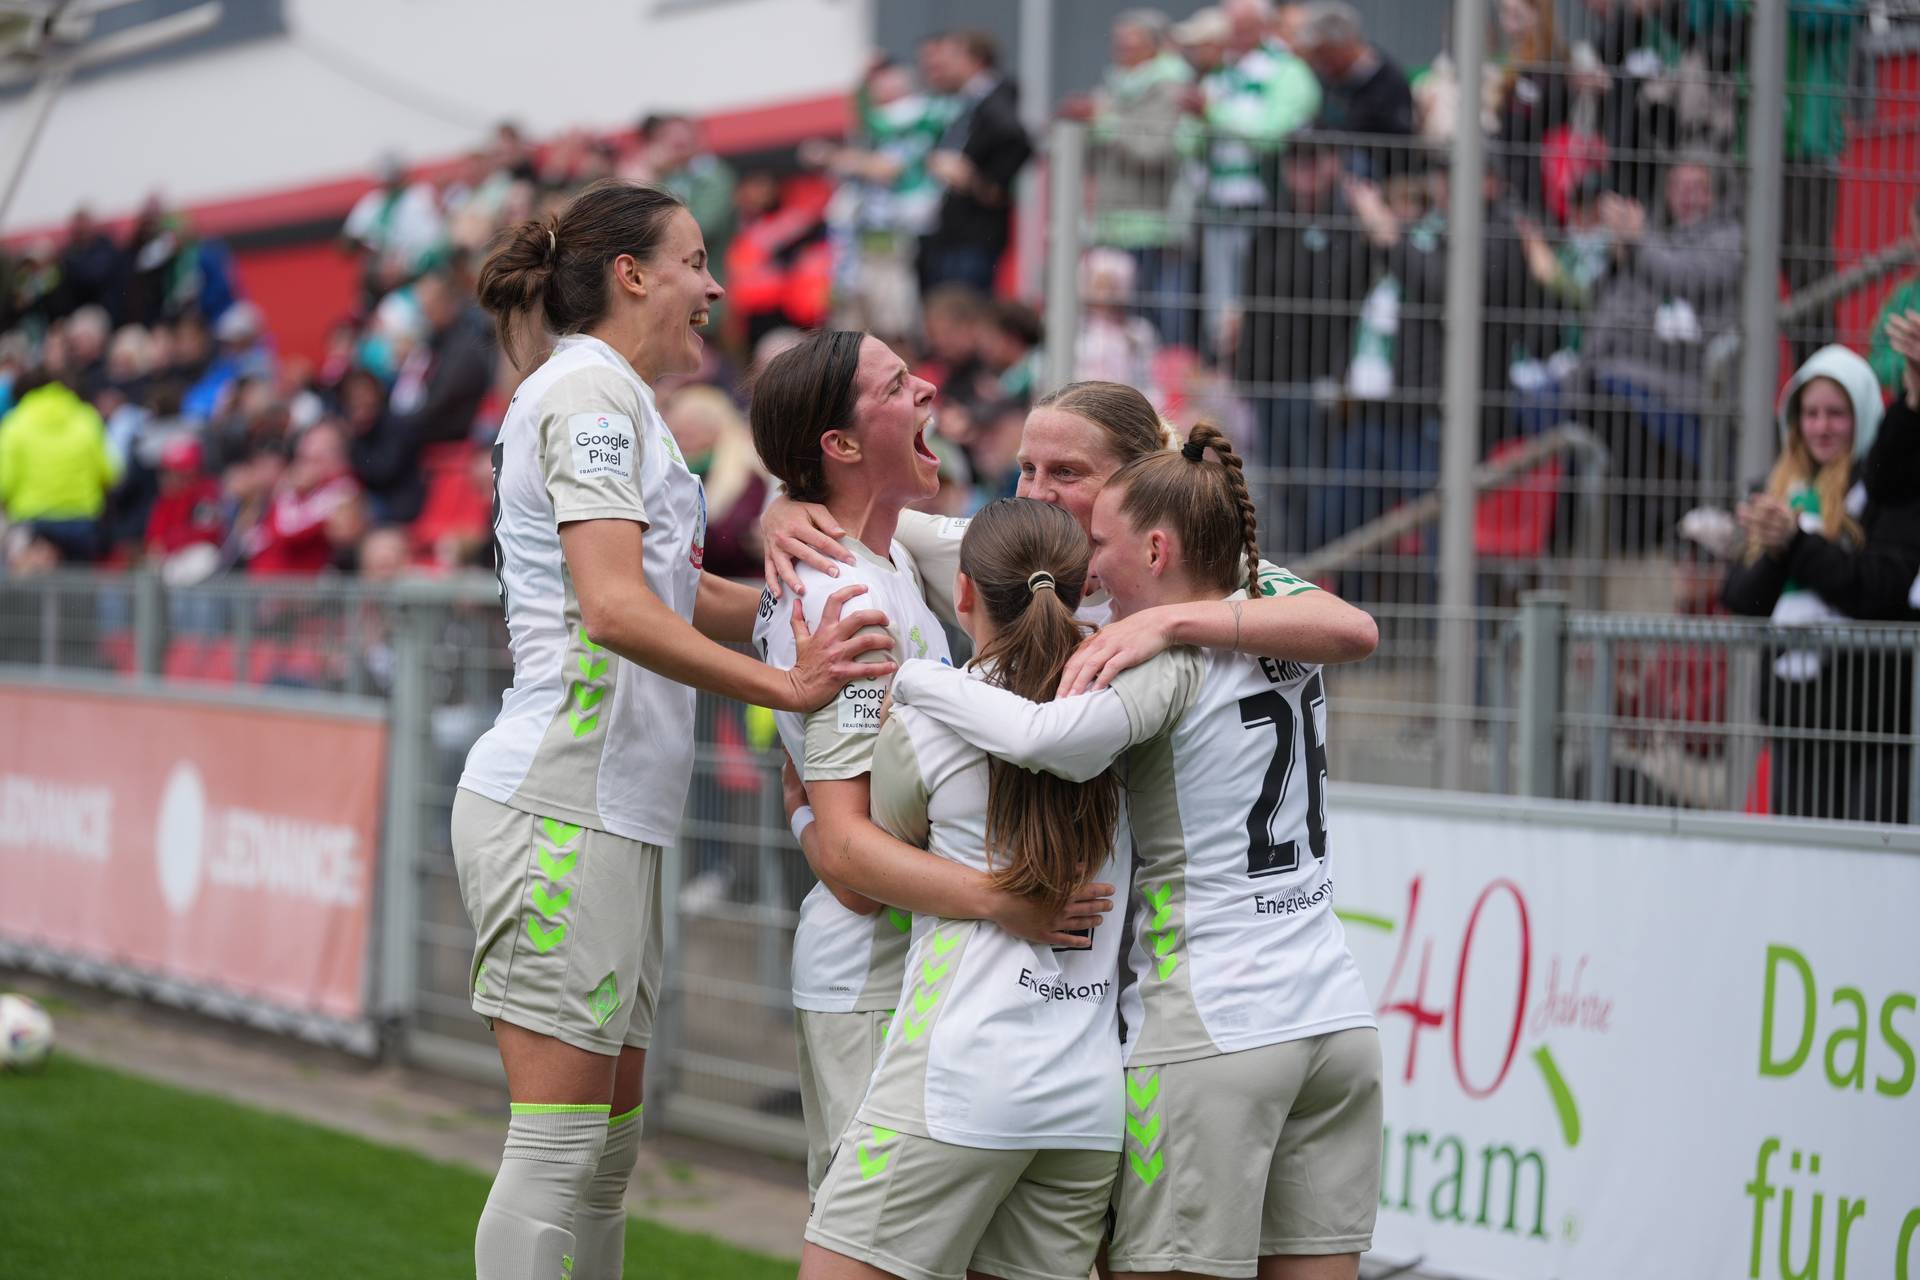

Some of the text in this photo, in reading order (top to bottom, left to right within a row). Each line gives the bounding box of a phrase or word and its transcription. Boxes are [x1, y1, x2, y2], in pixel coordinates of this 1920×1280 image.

[576, 432, 629, 450] Google
[589, 449, 621, 465] Pixel
[1379, 872, 1532, 1101] 40
[1758, 942, 1918, 1098] Das
[1745, 1135, 1866, 1280] für
